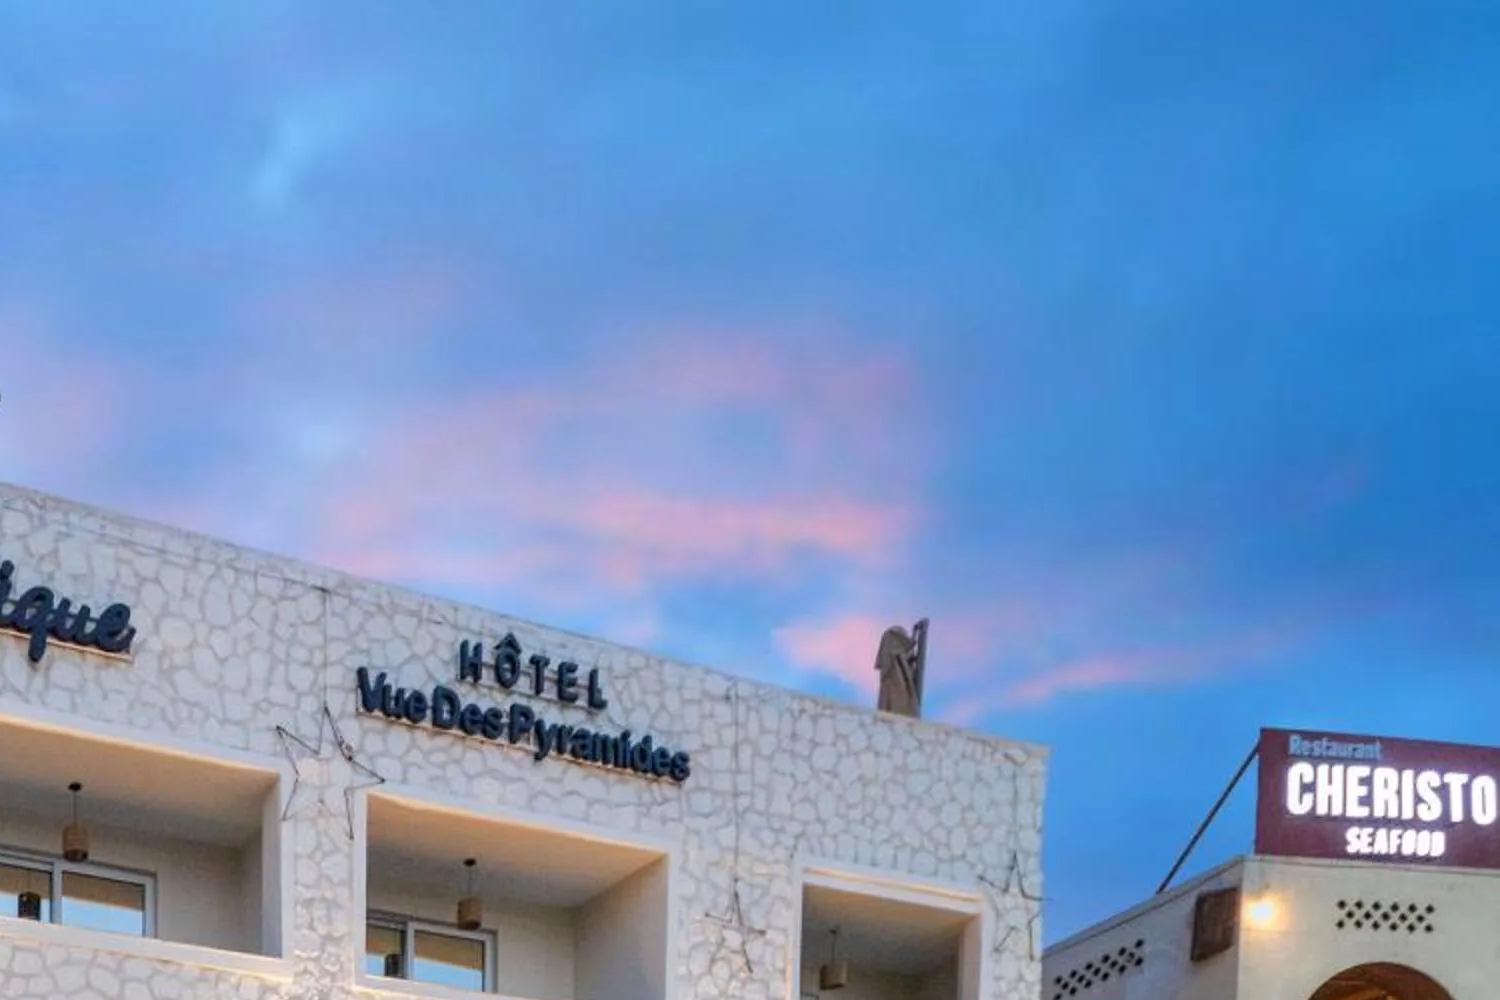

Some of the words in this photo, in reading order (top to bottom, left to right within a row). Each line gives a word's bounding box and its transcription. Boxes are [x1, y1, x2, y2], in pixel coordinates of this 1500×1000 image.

[458, 632, 608, 710] HÔTEL
[356, 666, 428, 723] Vue
[431, 684, 504, 739] Des
[508, 702, 691, 782] Pyramides
[1288, 733, 1381, 760] Restaurant
[1286, 761, 1498, 825] CHERISTO
[1345, 826, 1446, 857] SEAFOOD
